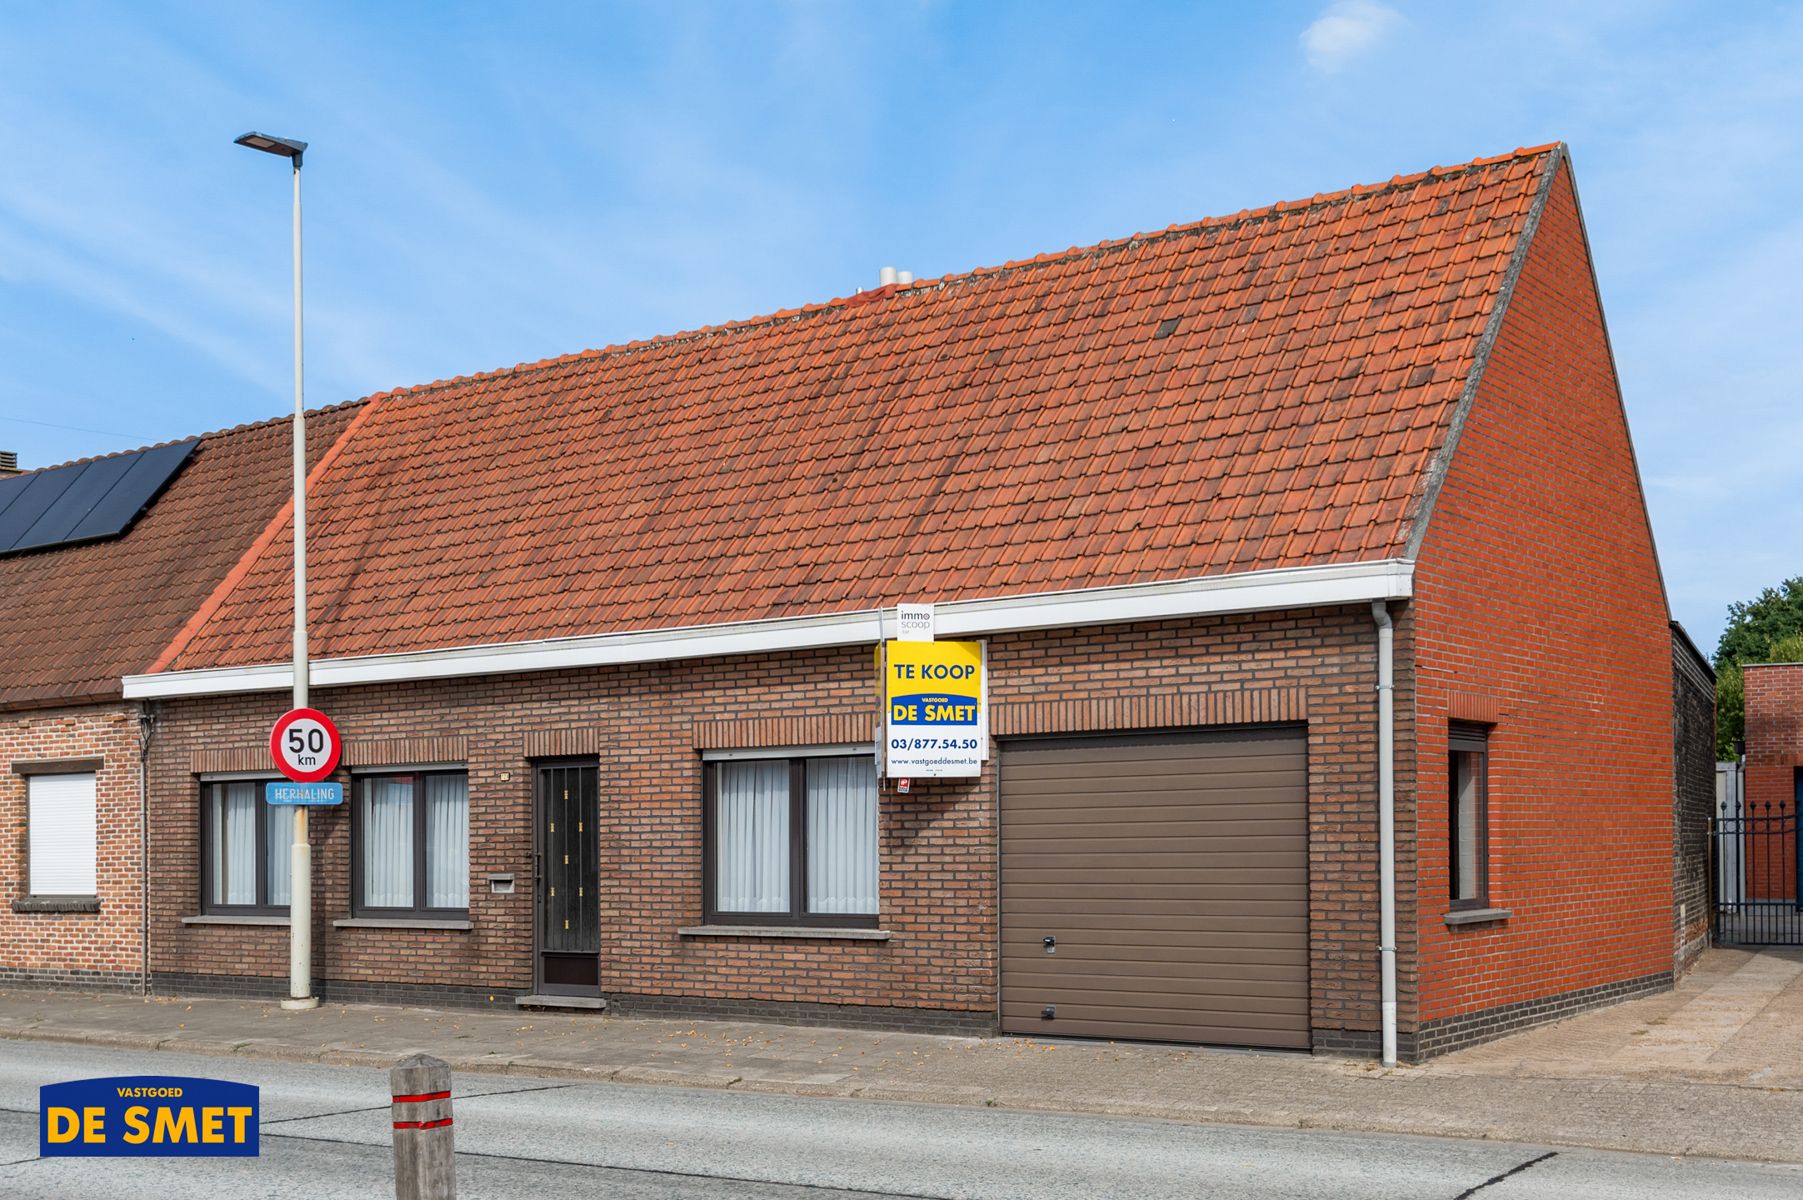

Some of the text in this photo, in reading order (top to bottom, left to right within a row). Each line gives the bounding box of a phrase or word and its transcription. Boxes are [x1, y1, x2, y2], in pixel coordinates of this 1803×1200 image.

[901, 610, 930, 621] immo
[901, 621, 930, 630] scoop
[894, 664, 975, 679] TE KOOP
[893, 704, 976, 721] DE SMET
[288, 728, 324, 754] 50
[891, 738, 978, 751] 03/877.54.50
[297, 754, 316, 766] km
[891, 757, 978, 767] www.vastgoeddesmet.be
[274, 788, 335, 800] HERHALING
